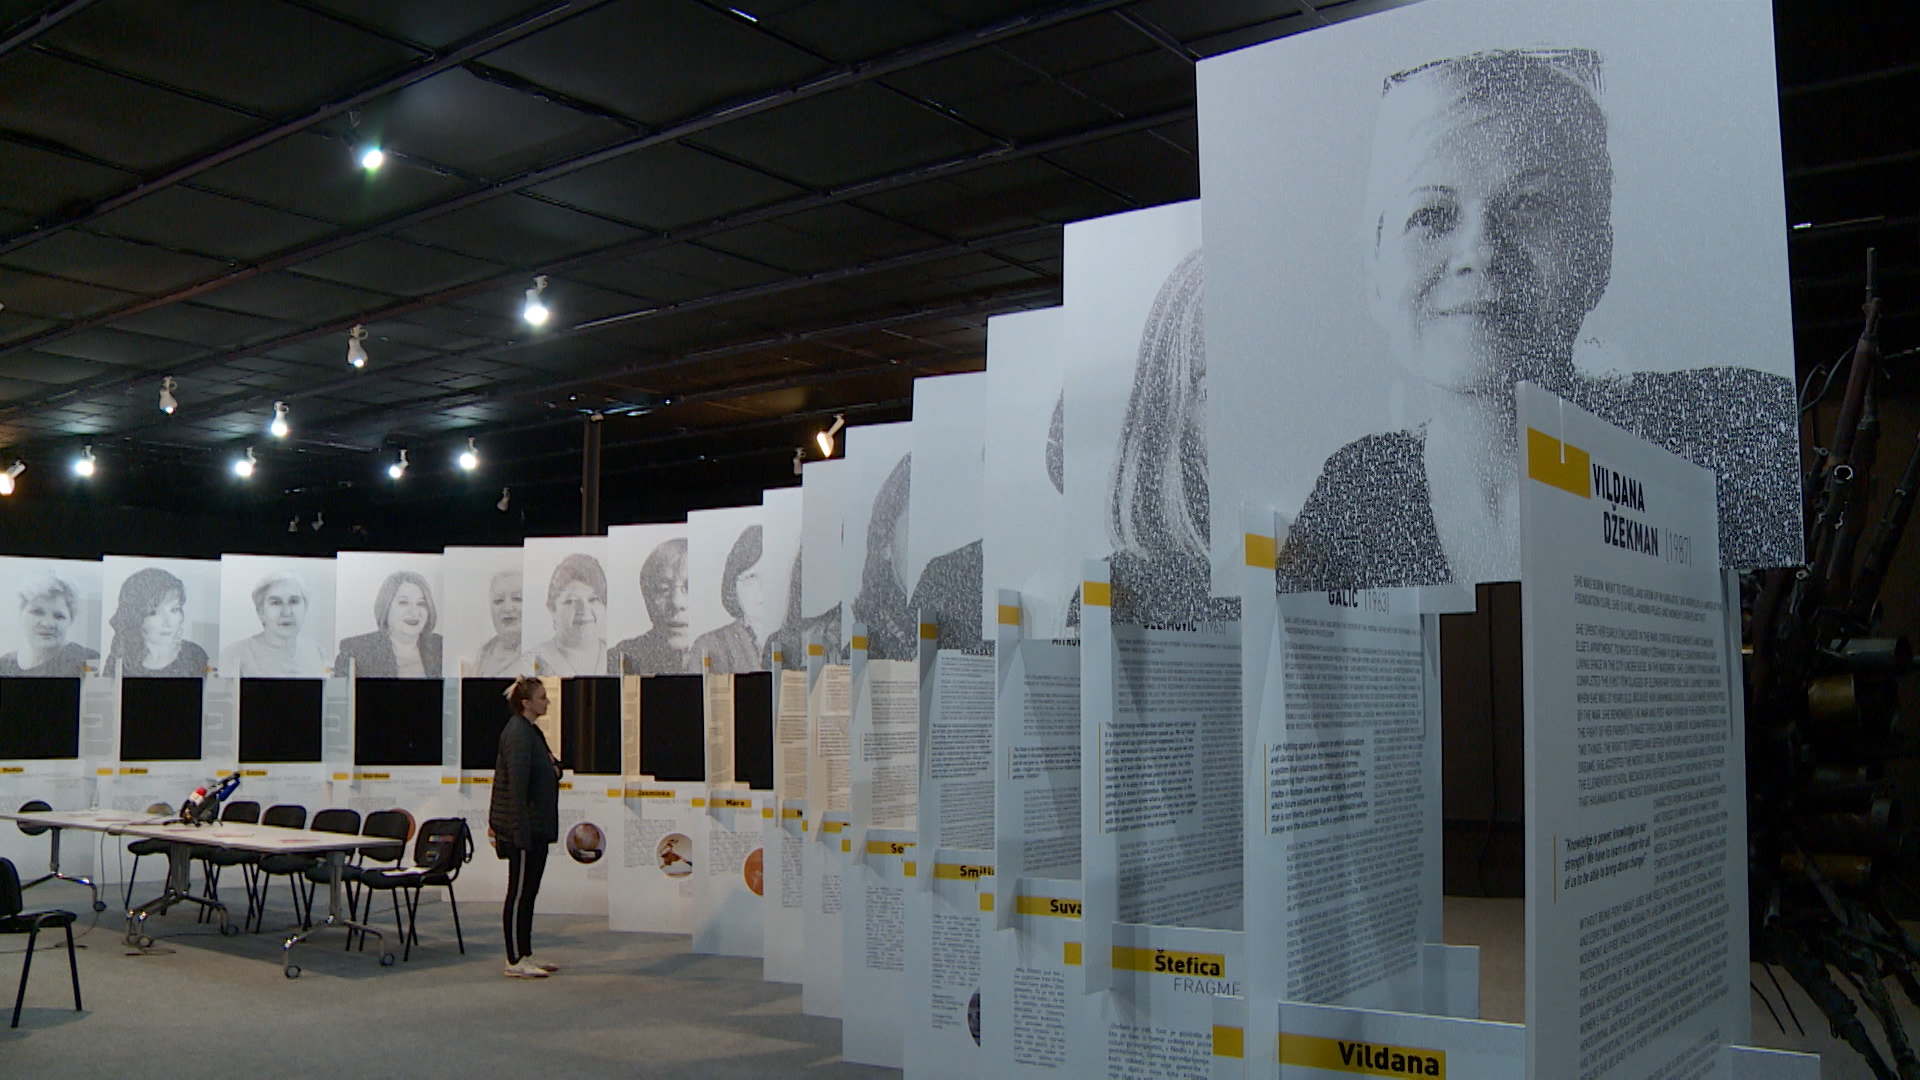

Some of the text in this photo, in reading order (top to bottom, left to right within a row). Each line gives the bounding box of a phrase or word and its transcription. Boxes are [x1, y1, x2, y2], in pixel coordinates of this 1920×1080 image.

[1593, 464, 1645, 513] VILDANA
[1603, 504, 1658, 557] DŽEKMAN
[1155, 948, 1220, 976] Štefica
[1338, 1041, 1439, 1077] Vildana
